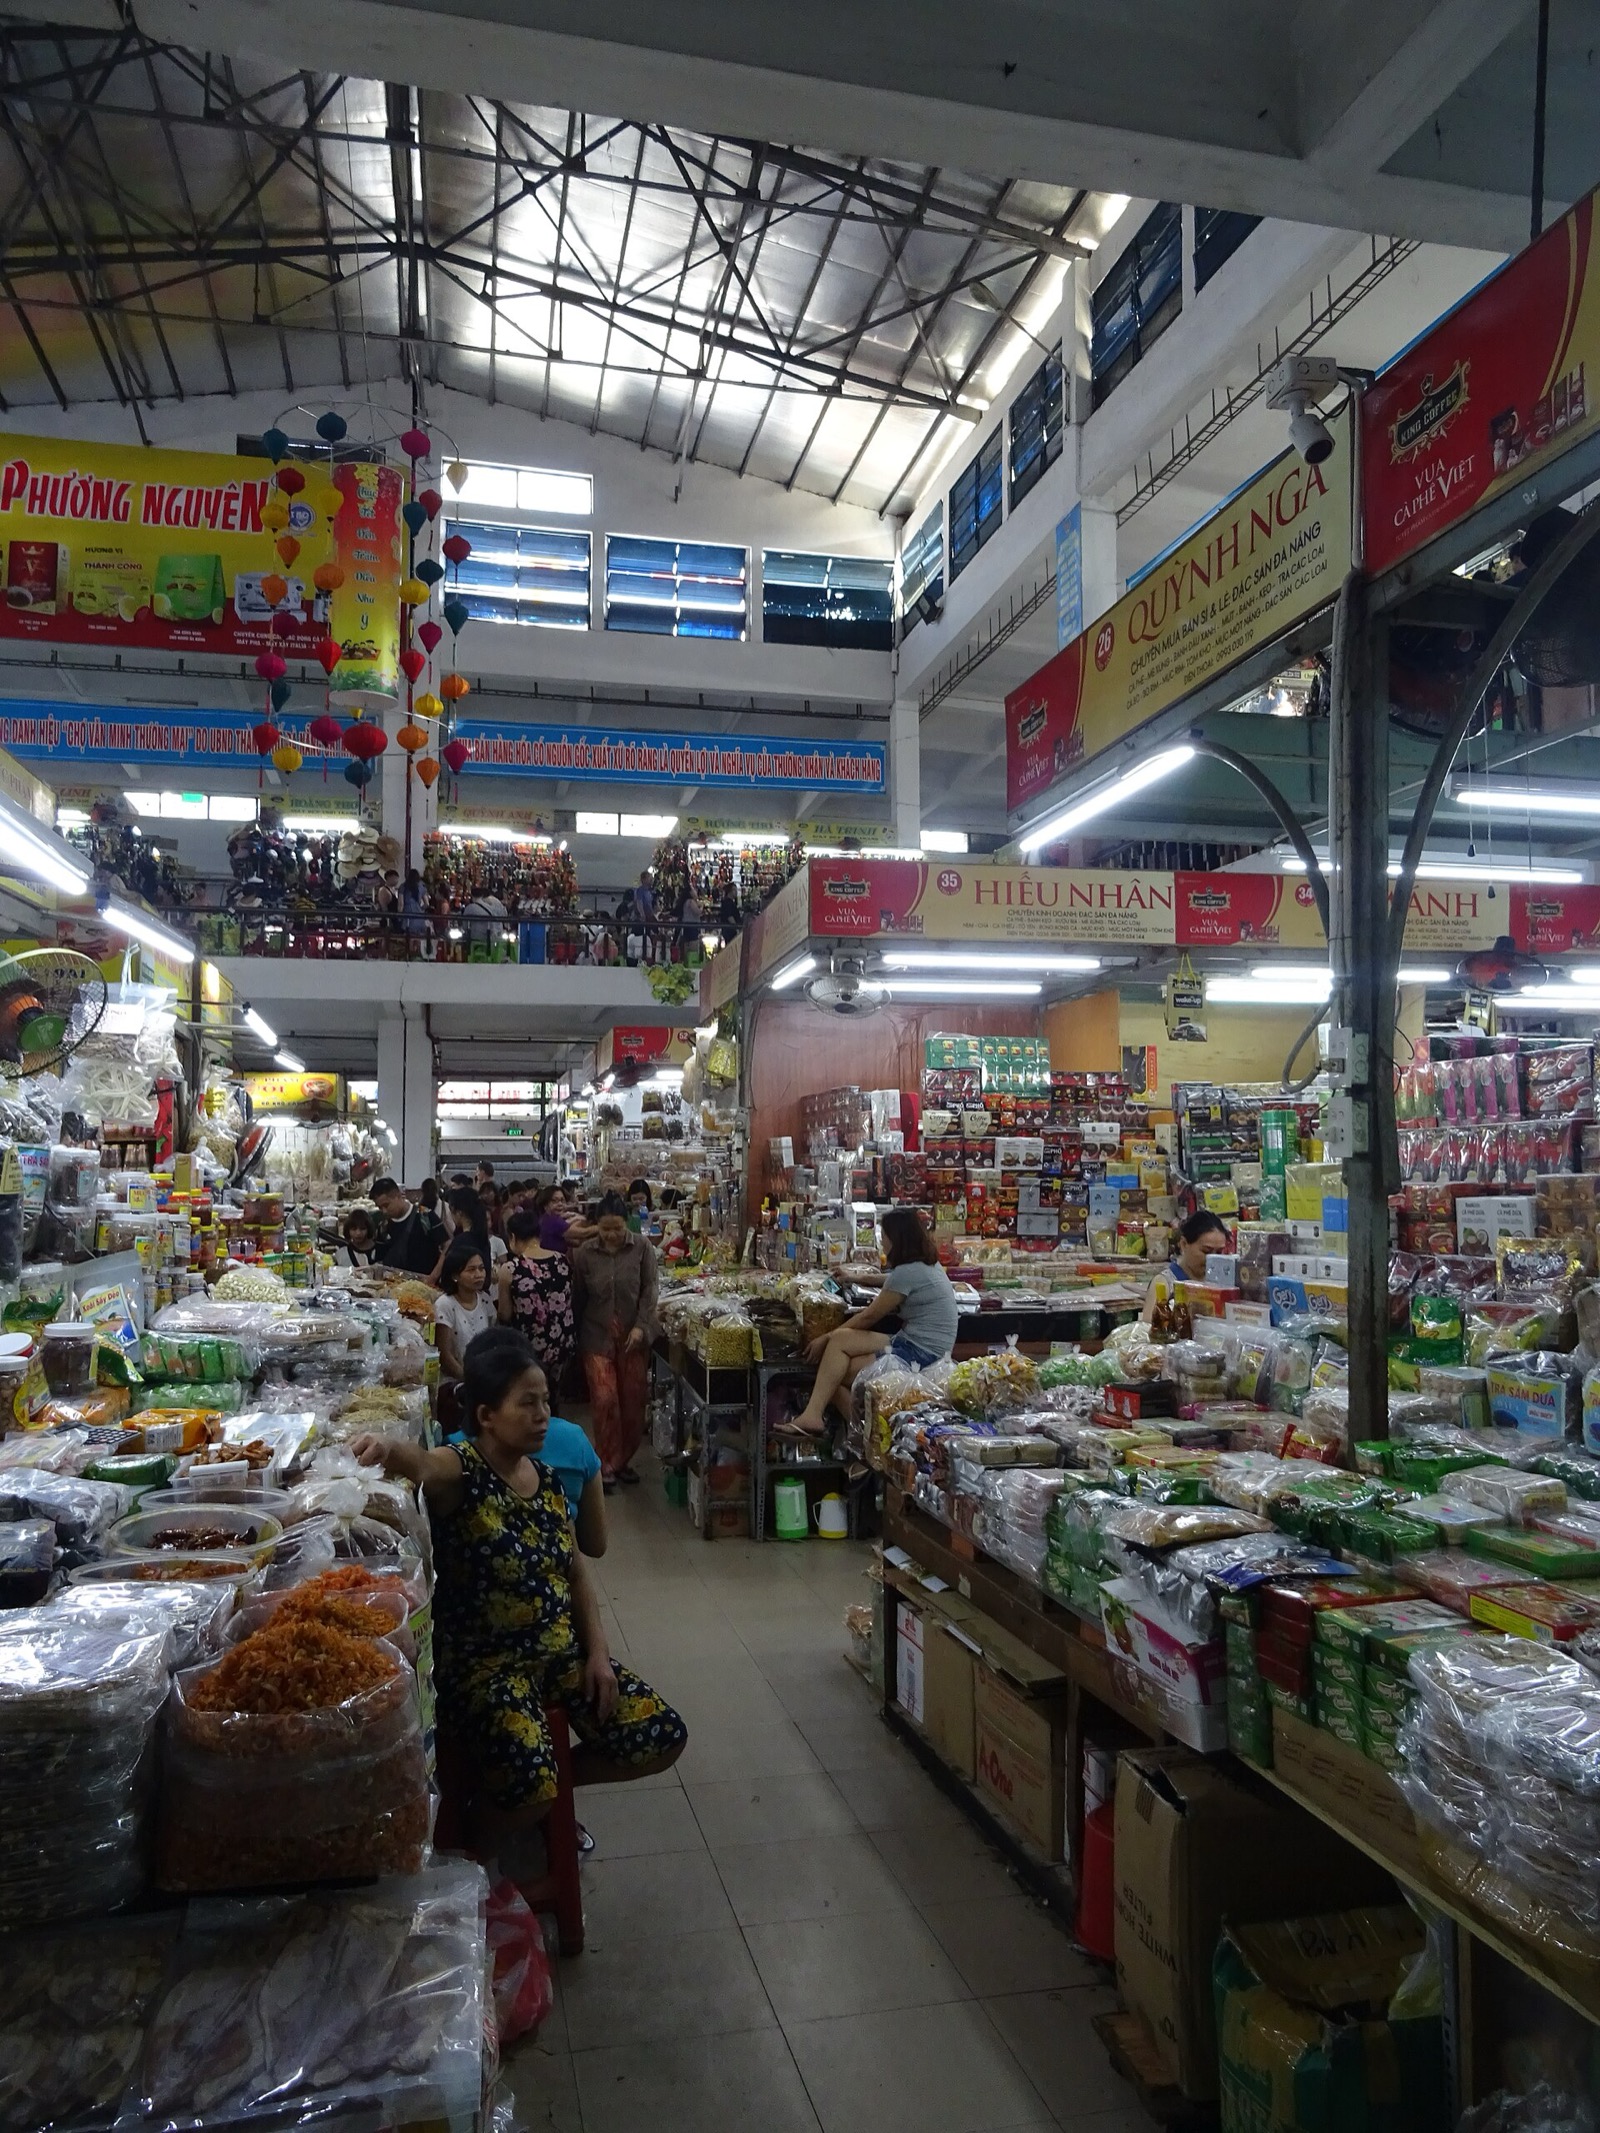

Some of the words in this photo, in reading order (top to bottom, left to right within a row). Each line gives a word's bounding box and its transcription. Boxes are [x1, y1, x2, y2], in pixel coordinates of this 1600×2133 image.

[1400, 420, 1422, 445] KING
[1423, 389, 1459, 426] COFFEE
[1414, 458, 1446, 490] VUA
[1437, 455, 1476, 499] VIỆT
[142, 481, 269, 534] NGUYÊN
[1128, 520, 1241, 645] QUỲNH
[1249, 462, 1330, 558] NGA
[1098, 627, 1111, 658] 26
[1130, 643, 1162, 676] CHUYÊN
[10, 717, 37, 746] DANH
[37, 713, 61, 753] HIỆU
[87, 716, 106, 749] VĂN
[107, 722, 133, 750] MINH
[194, 727, 208, 753] DO
[209, 727, 234, 754] UBND
[473, 732, 490, 763] BÁN
[491, 733, 514, 765] HÀNG
[546, 734, 574, 768] NGUỒN
[592, 736, 612, 770] XUẤT
[637, 741, 658, 772] RÀNG
[659, 742, 670, 773] LÀ
[709, 744, 721, 775] VÀ
[757, 745, 772, 778] CỦA
[803, 749, 824, 780] NHÂN
[824, 751, 835, 780] VÀ
[835, 751, 862, 781] KHÁCH
[862, 752, 882, 782] HÀNG
[941, 873, 958, 887] 35
[974, 870, 1059, 907] HIẾU
[1068, 877, 1173, 910] NHÂN
[1123, 1886, 1152, 1926] FILTER
[1138, 1922, 1178, 1973] WHITE
